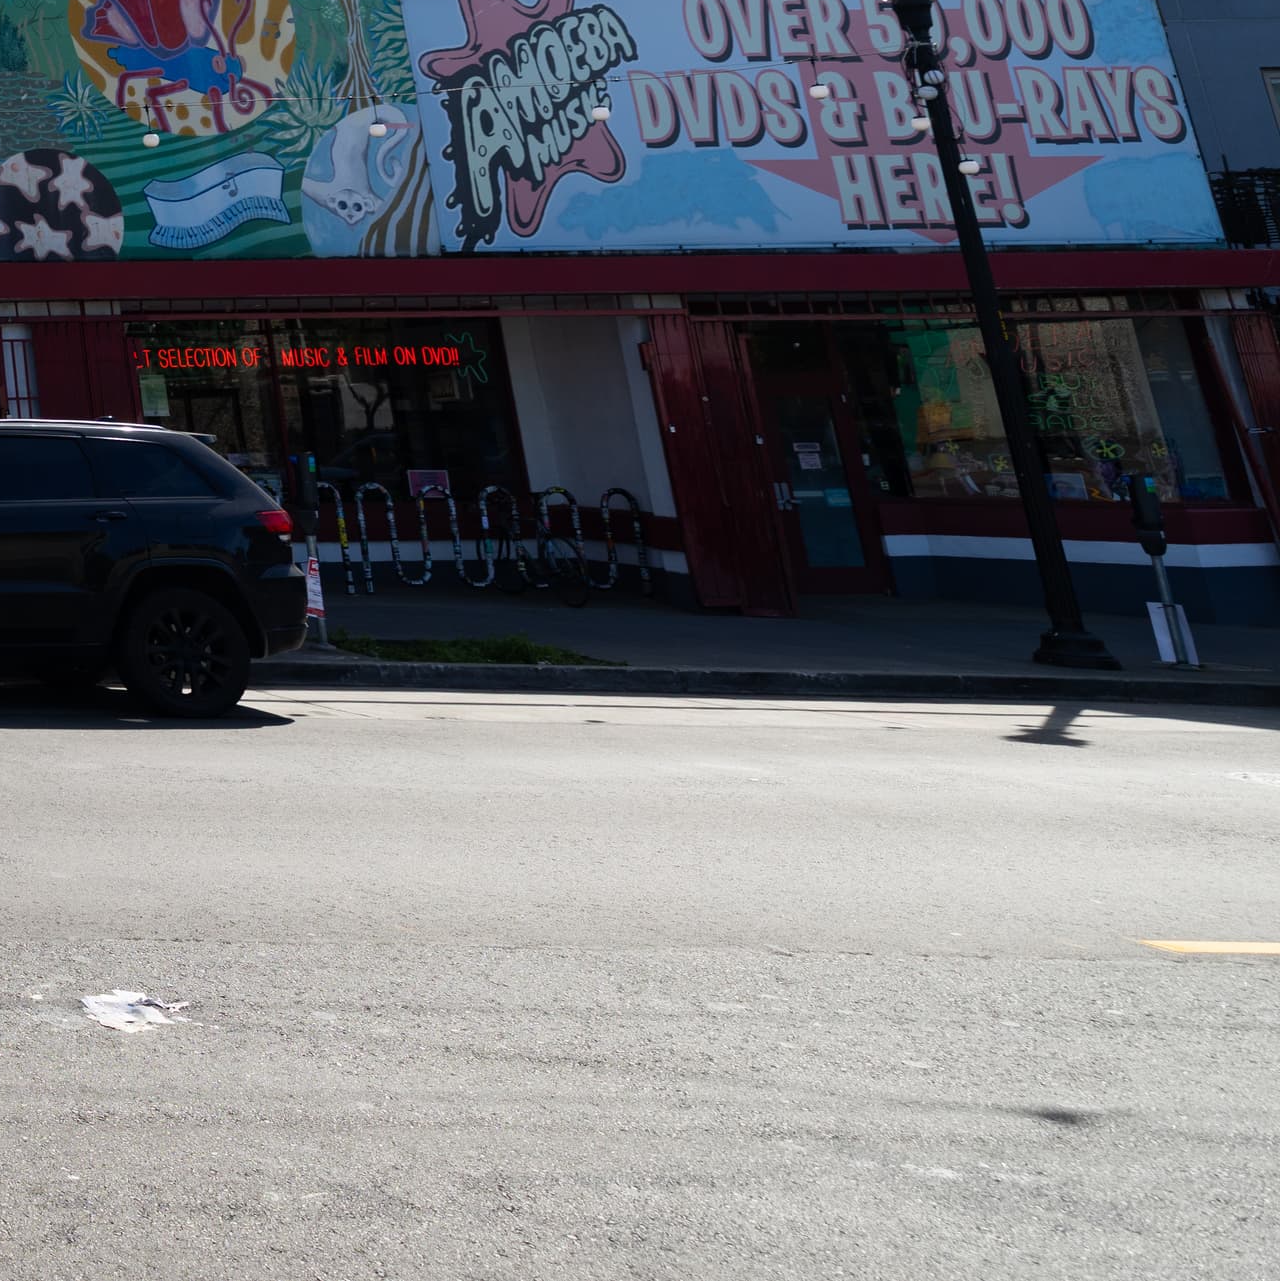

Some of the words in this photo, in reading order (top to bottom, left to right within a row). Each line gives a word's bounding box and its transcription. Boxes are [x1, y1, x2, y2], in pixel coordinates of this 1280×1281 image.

[461, 6, 636, 217] AMOEBA
[816, 69, 869, 147] &
[872, 66, 1193, 147] BU-RAYS
[156, 346, 238, 369] SELECTION
[241, 346, 262, 368] OF
[281, 346, 331, 368] MUSIC
[337, 348, 349, 367] &
[354, 346, 389, 366] FILM
[393, 345, 417, 367] ON
[421, 345, 460, 367] DVD!!
